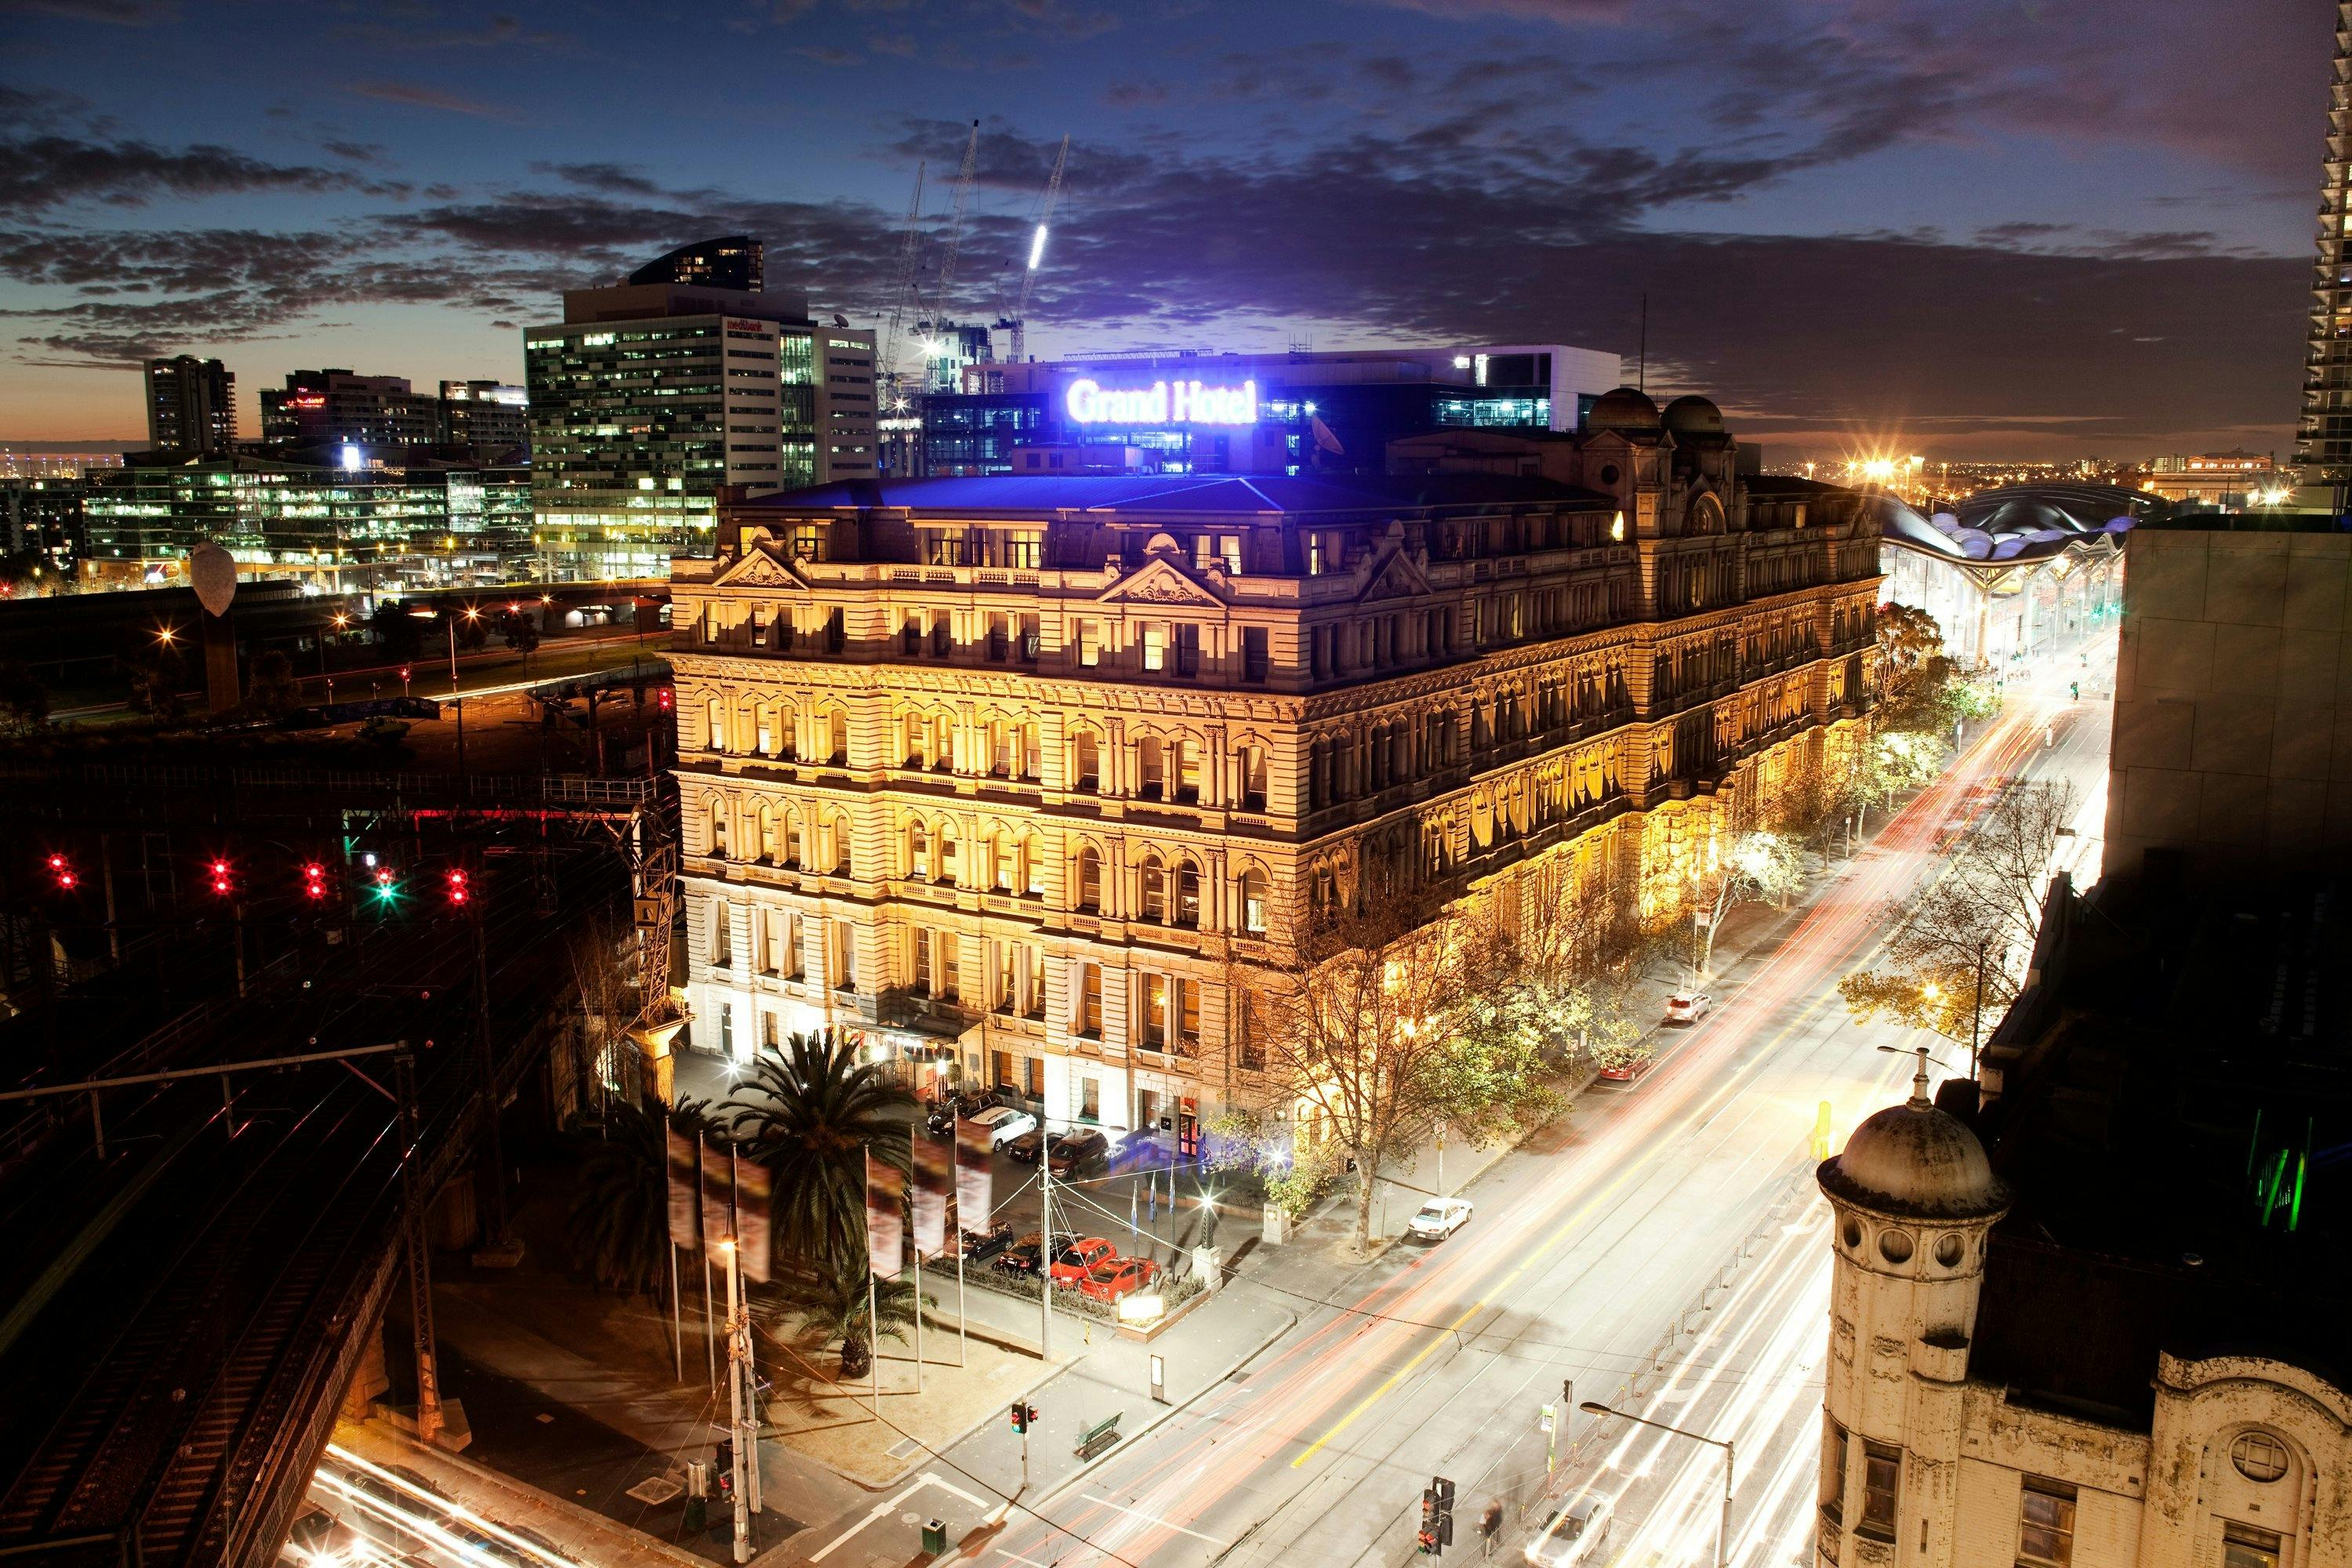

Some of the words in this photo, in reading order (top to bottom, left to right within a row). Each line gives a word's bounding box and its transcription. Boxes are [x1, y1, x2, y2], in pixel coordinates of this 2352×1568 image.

[727, 319, 763, 332] medibank
[1067, 379, 1167, 423] Grand
[1173, 380, 1258, 423] Hotel
